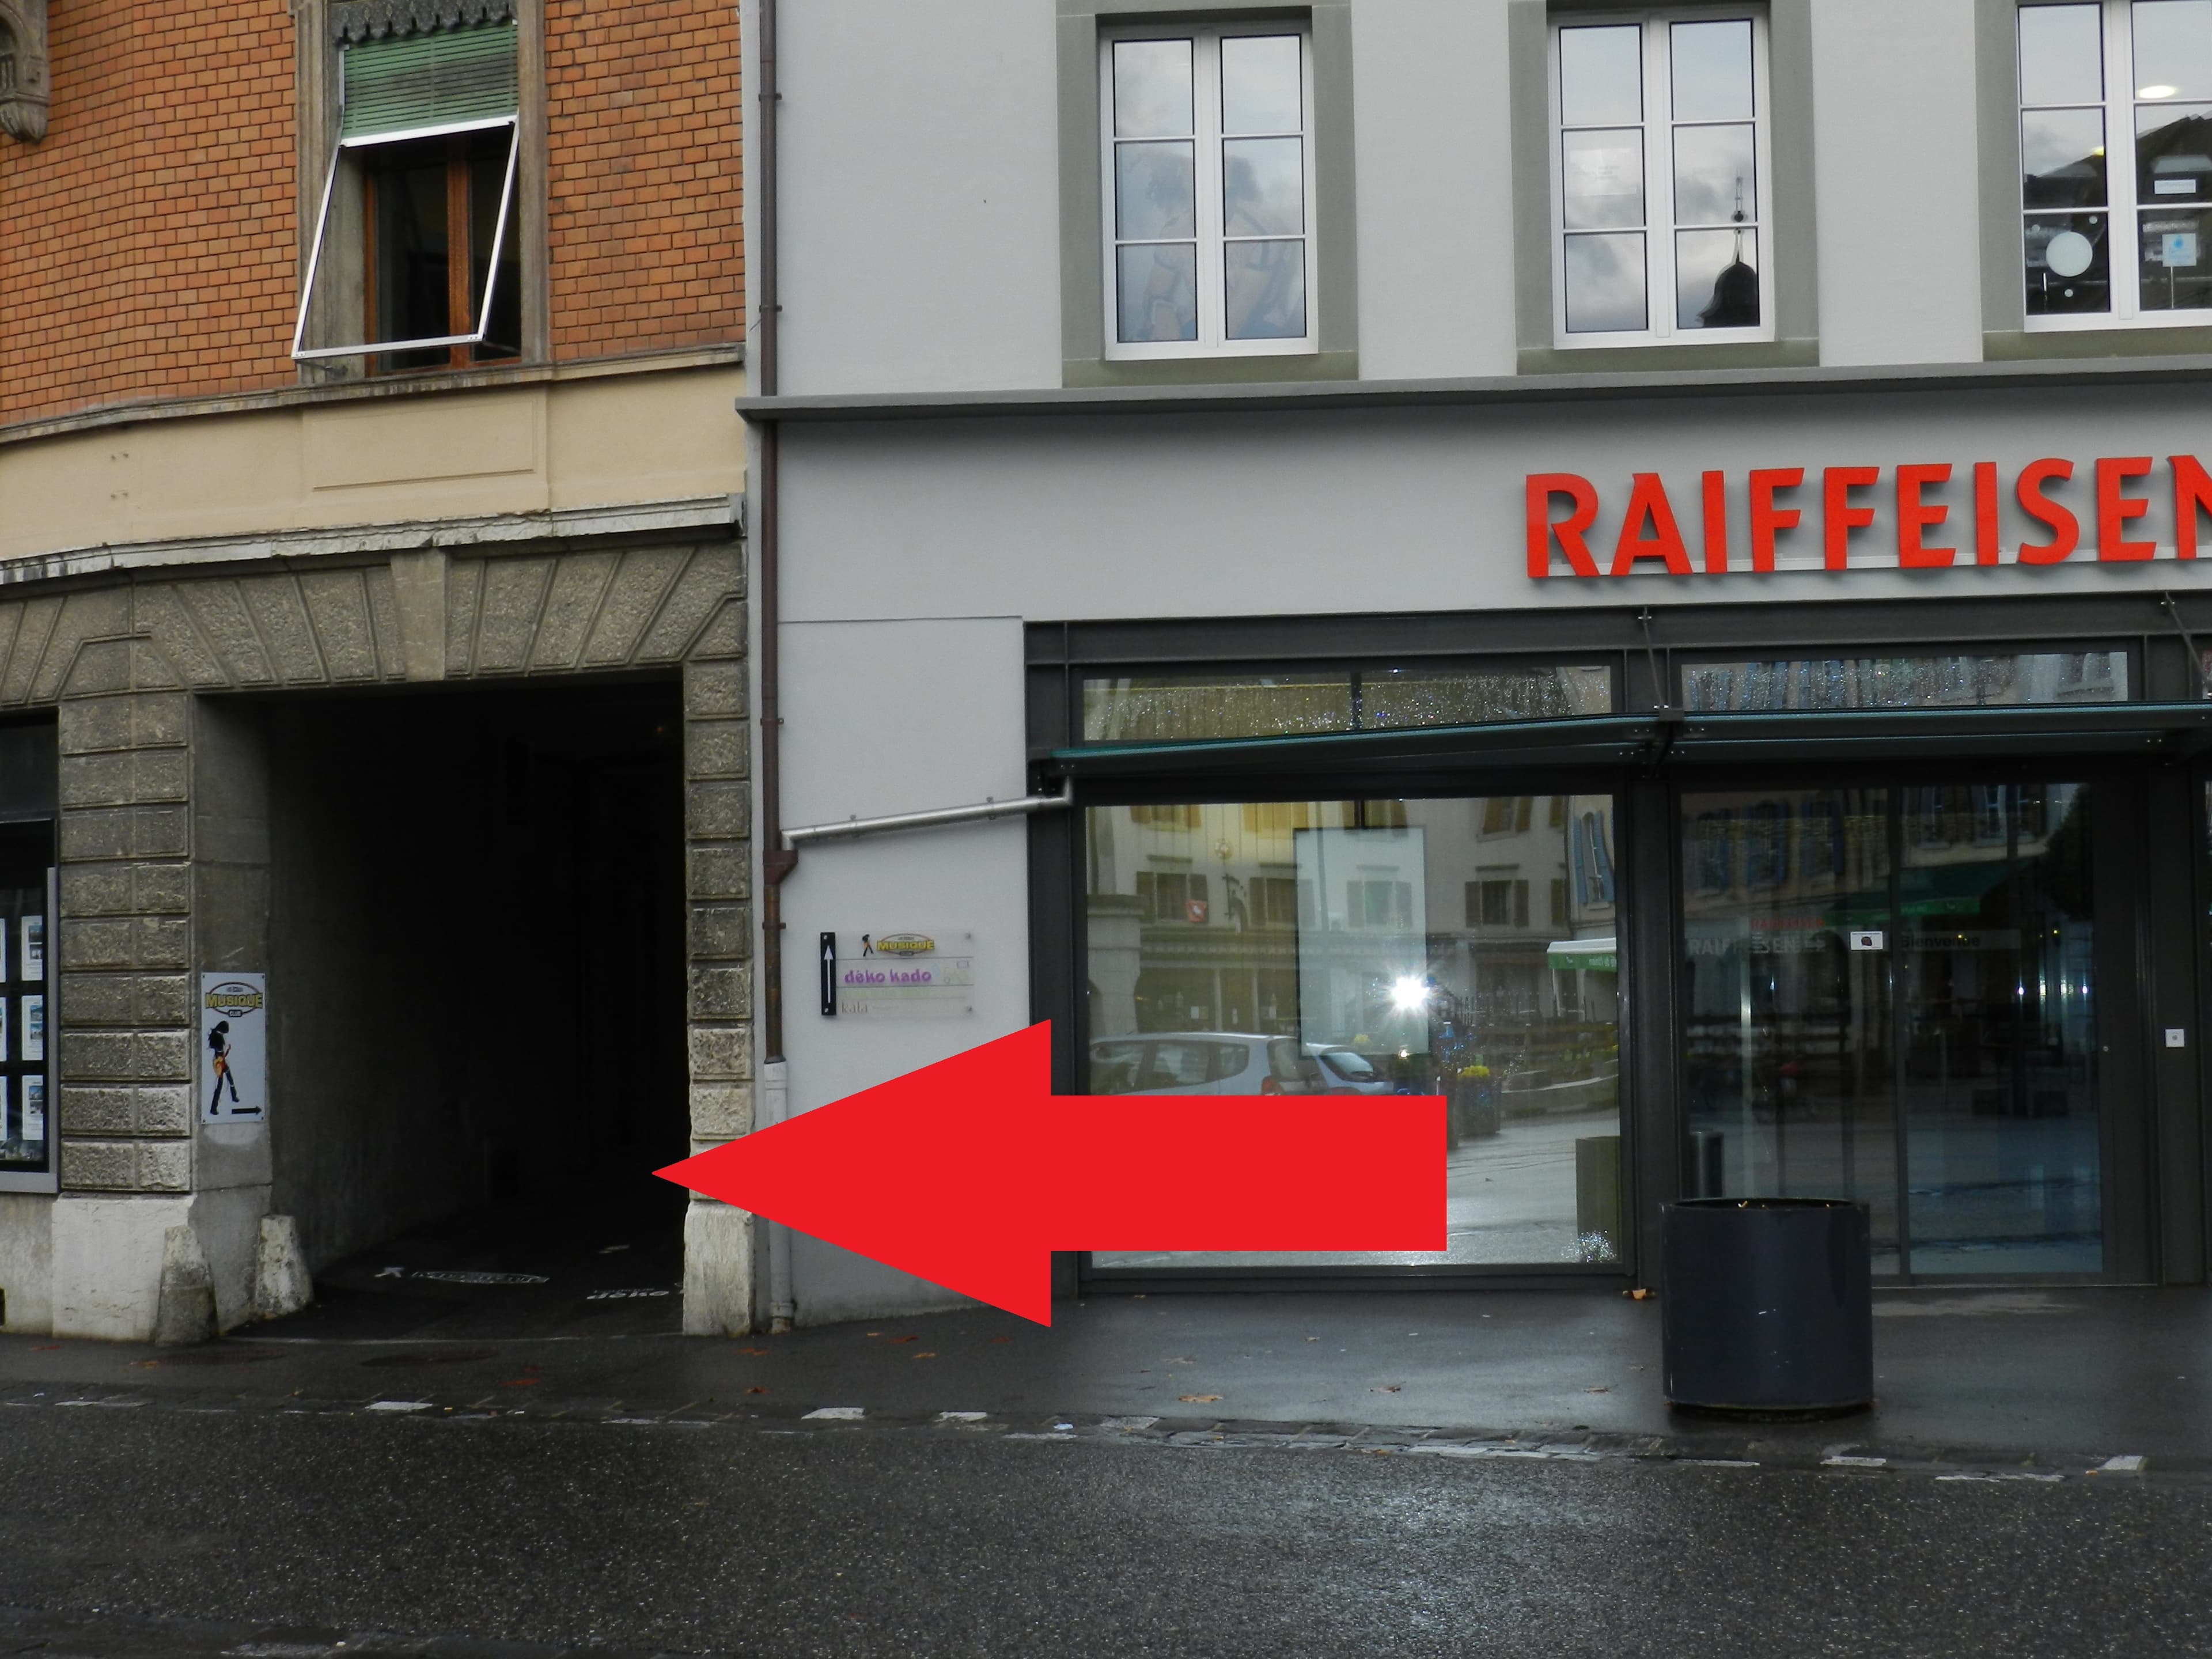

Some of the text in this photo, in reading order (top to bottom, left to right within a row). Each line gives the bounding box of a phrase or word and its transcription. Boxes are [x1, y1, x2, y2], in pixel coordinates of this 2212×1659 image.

[1527, 454, 2212, 577] RAIFFEISEN
[876, 940, 934, 952] MUSIQUE
[890, 968, 931, 982] kado
[205, 992, 263, 1009] MUSIQUE
